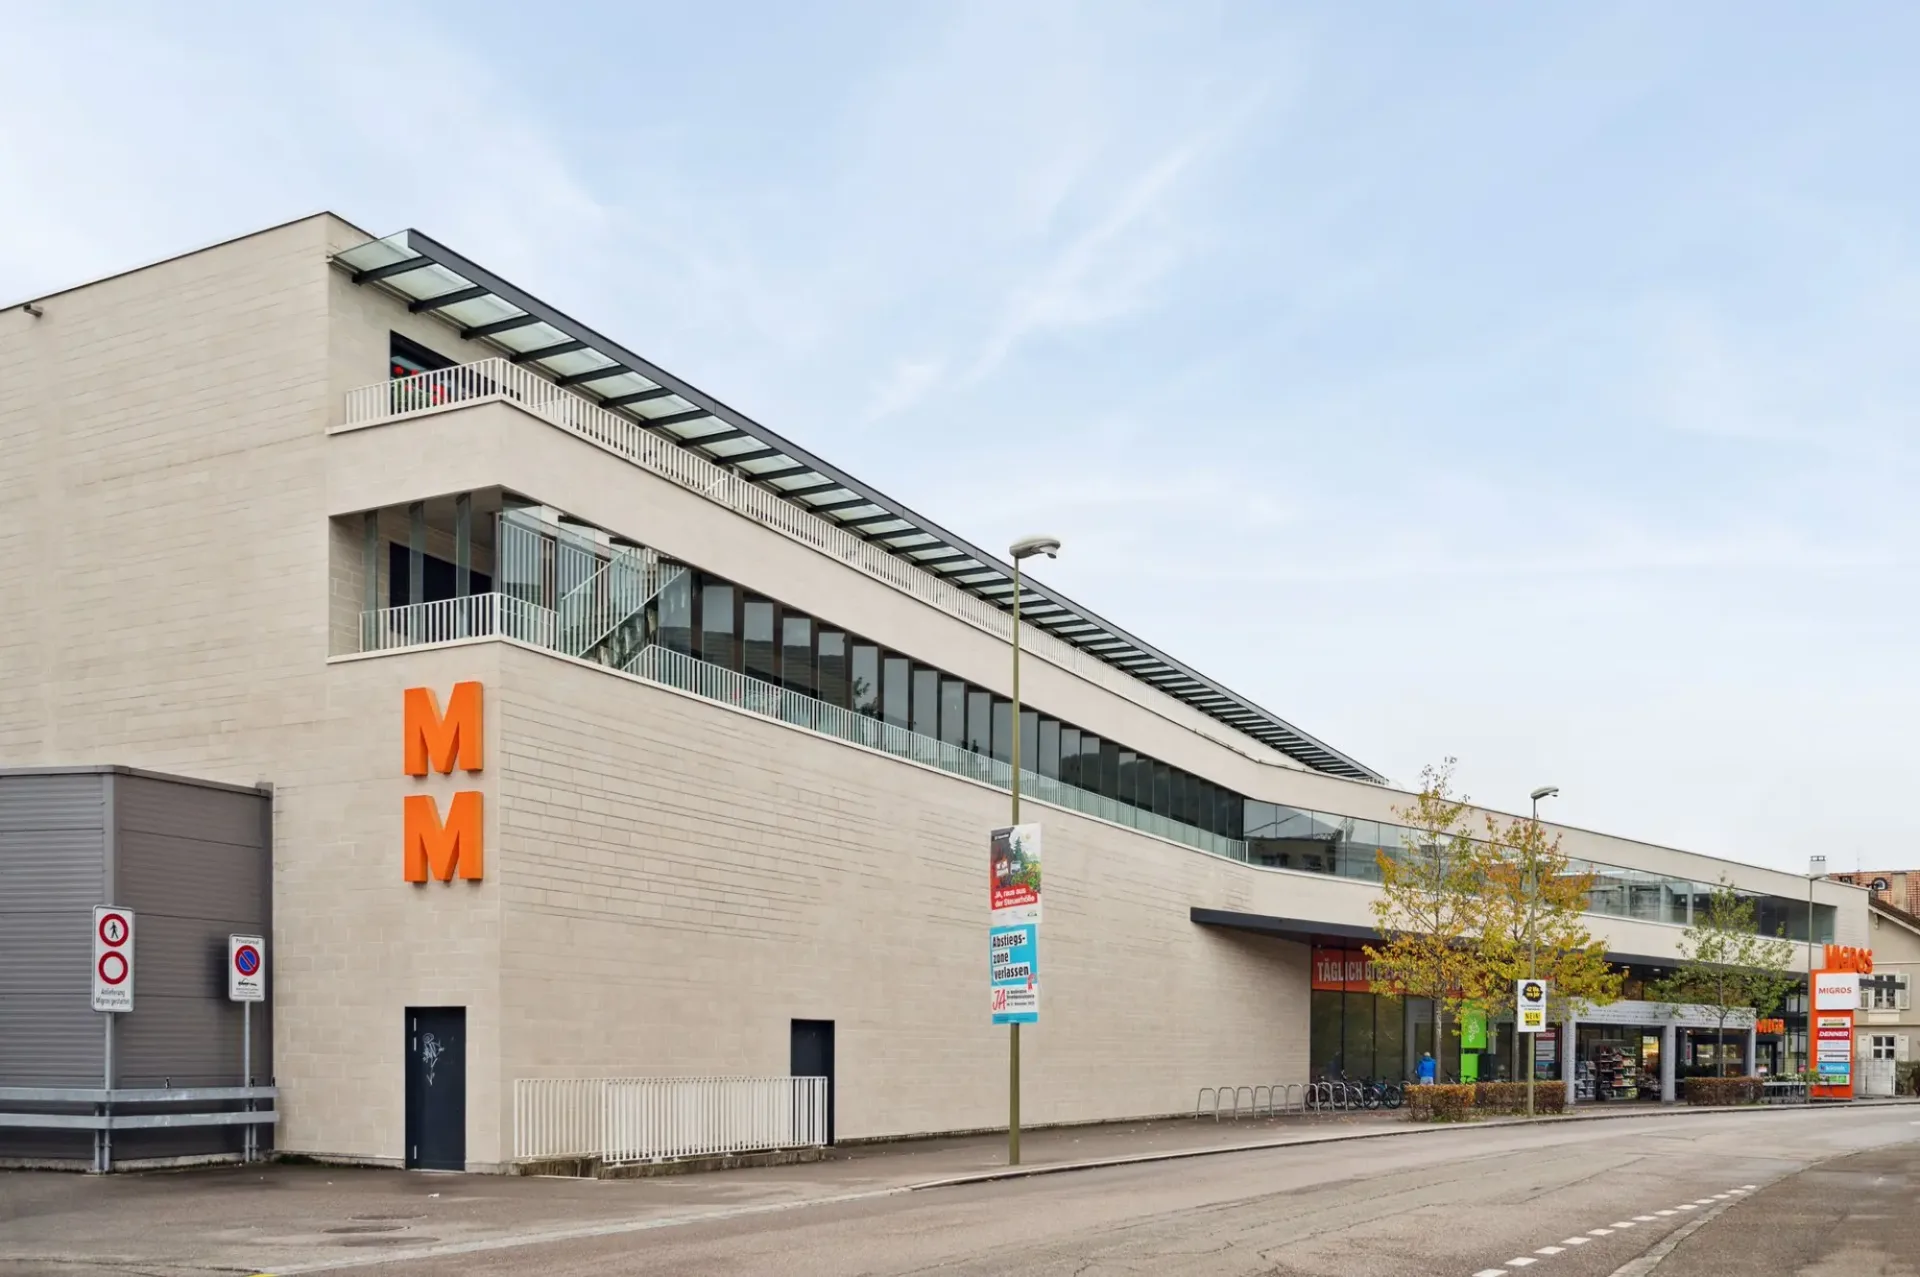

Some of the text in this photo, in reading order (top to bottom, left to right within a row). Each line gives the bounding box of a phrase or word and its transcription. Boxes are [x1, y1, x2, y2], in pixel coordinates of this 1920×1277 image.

[404, 681, 483, 776] M
[404, 791, 483, 883] M
[992, 933, 1025, 948] Abstiegs-
[993, 951, 1009, 964] zone
[994, 965, 1029, 981] verlassen
[1317, 957, 1363, 982] TÄGLICH
[992, 988, 1007, 1010] JA
